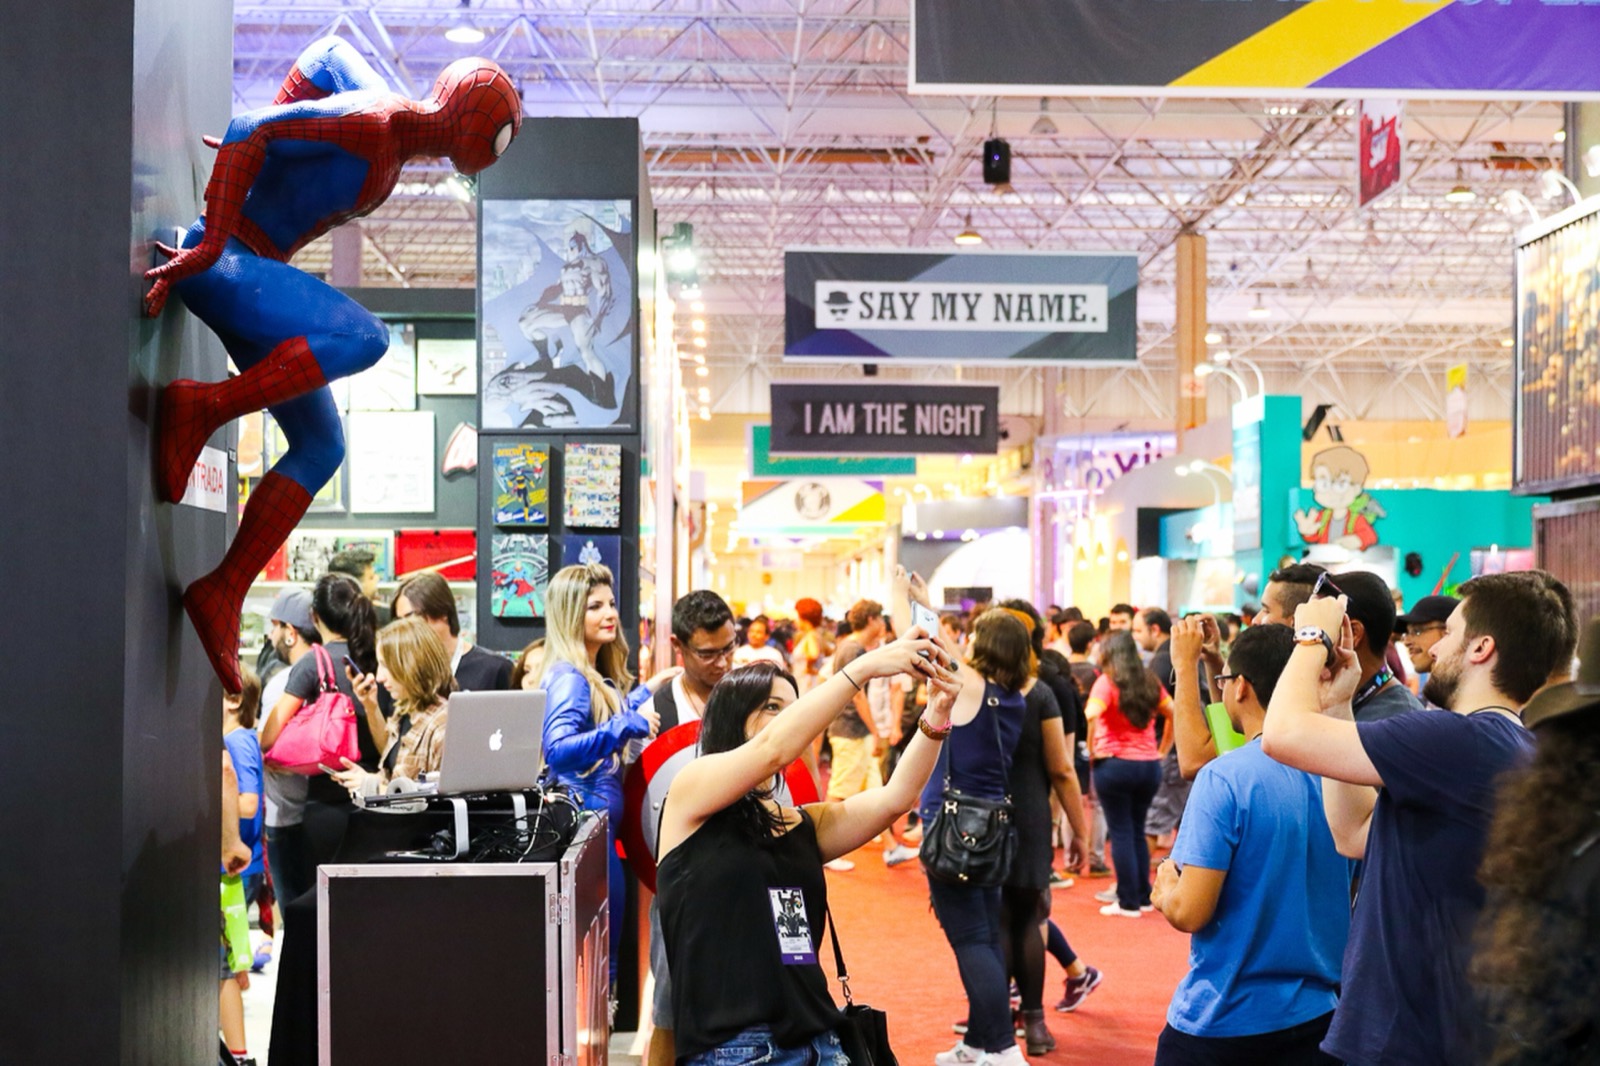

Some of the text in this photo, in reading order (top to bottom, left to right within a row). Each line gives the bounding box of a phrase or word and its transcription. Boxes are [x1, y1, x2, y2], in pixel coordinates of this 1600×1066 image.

[859, 290, 1098, 323] SAY MY NAME.
[804, 402, 985, 436] I AM THE NIGHT
[187, 461, 224, 496] NTRADA
